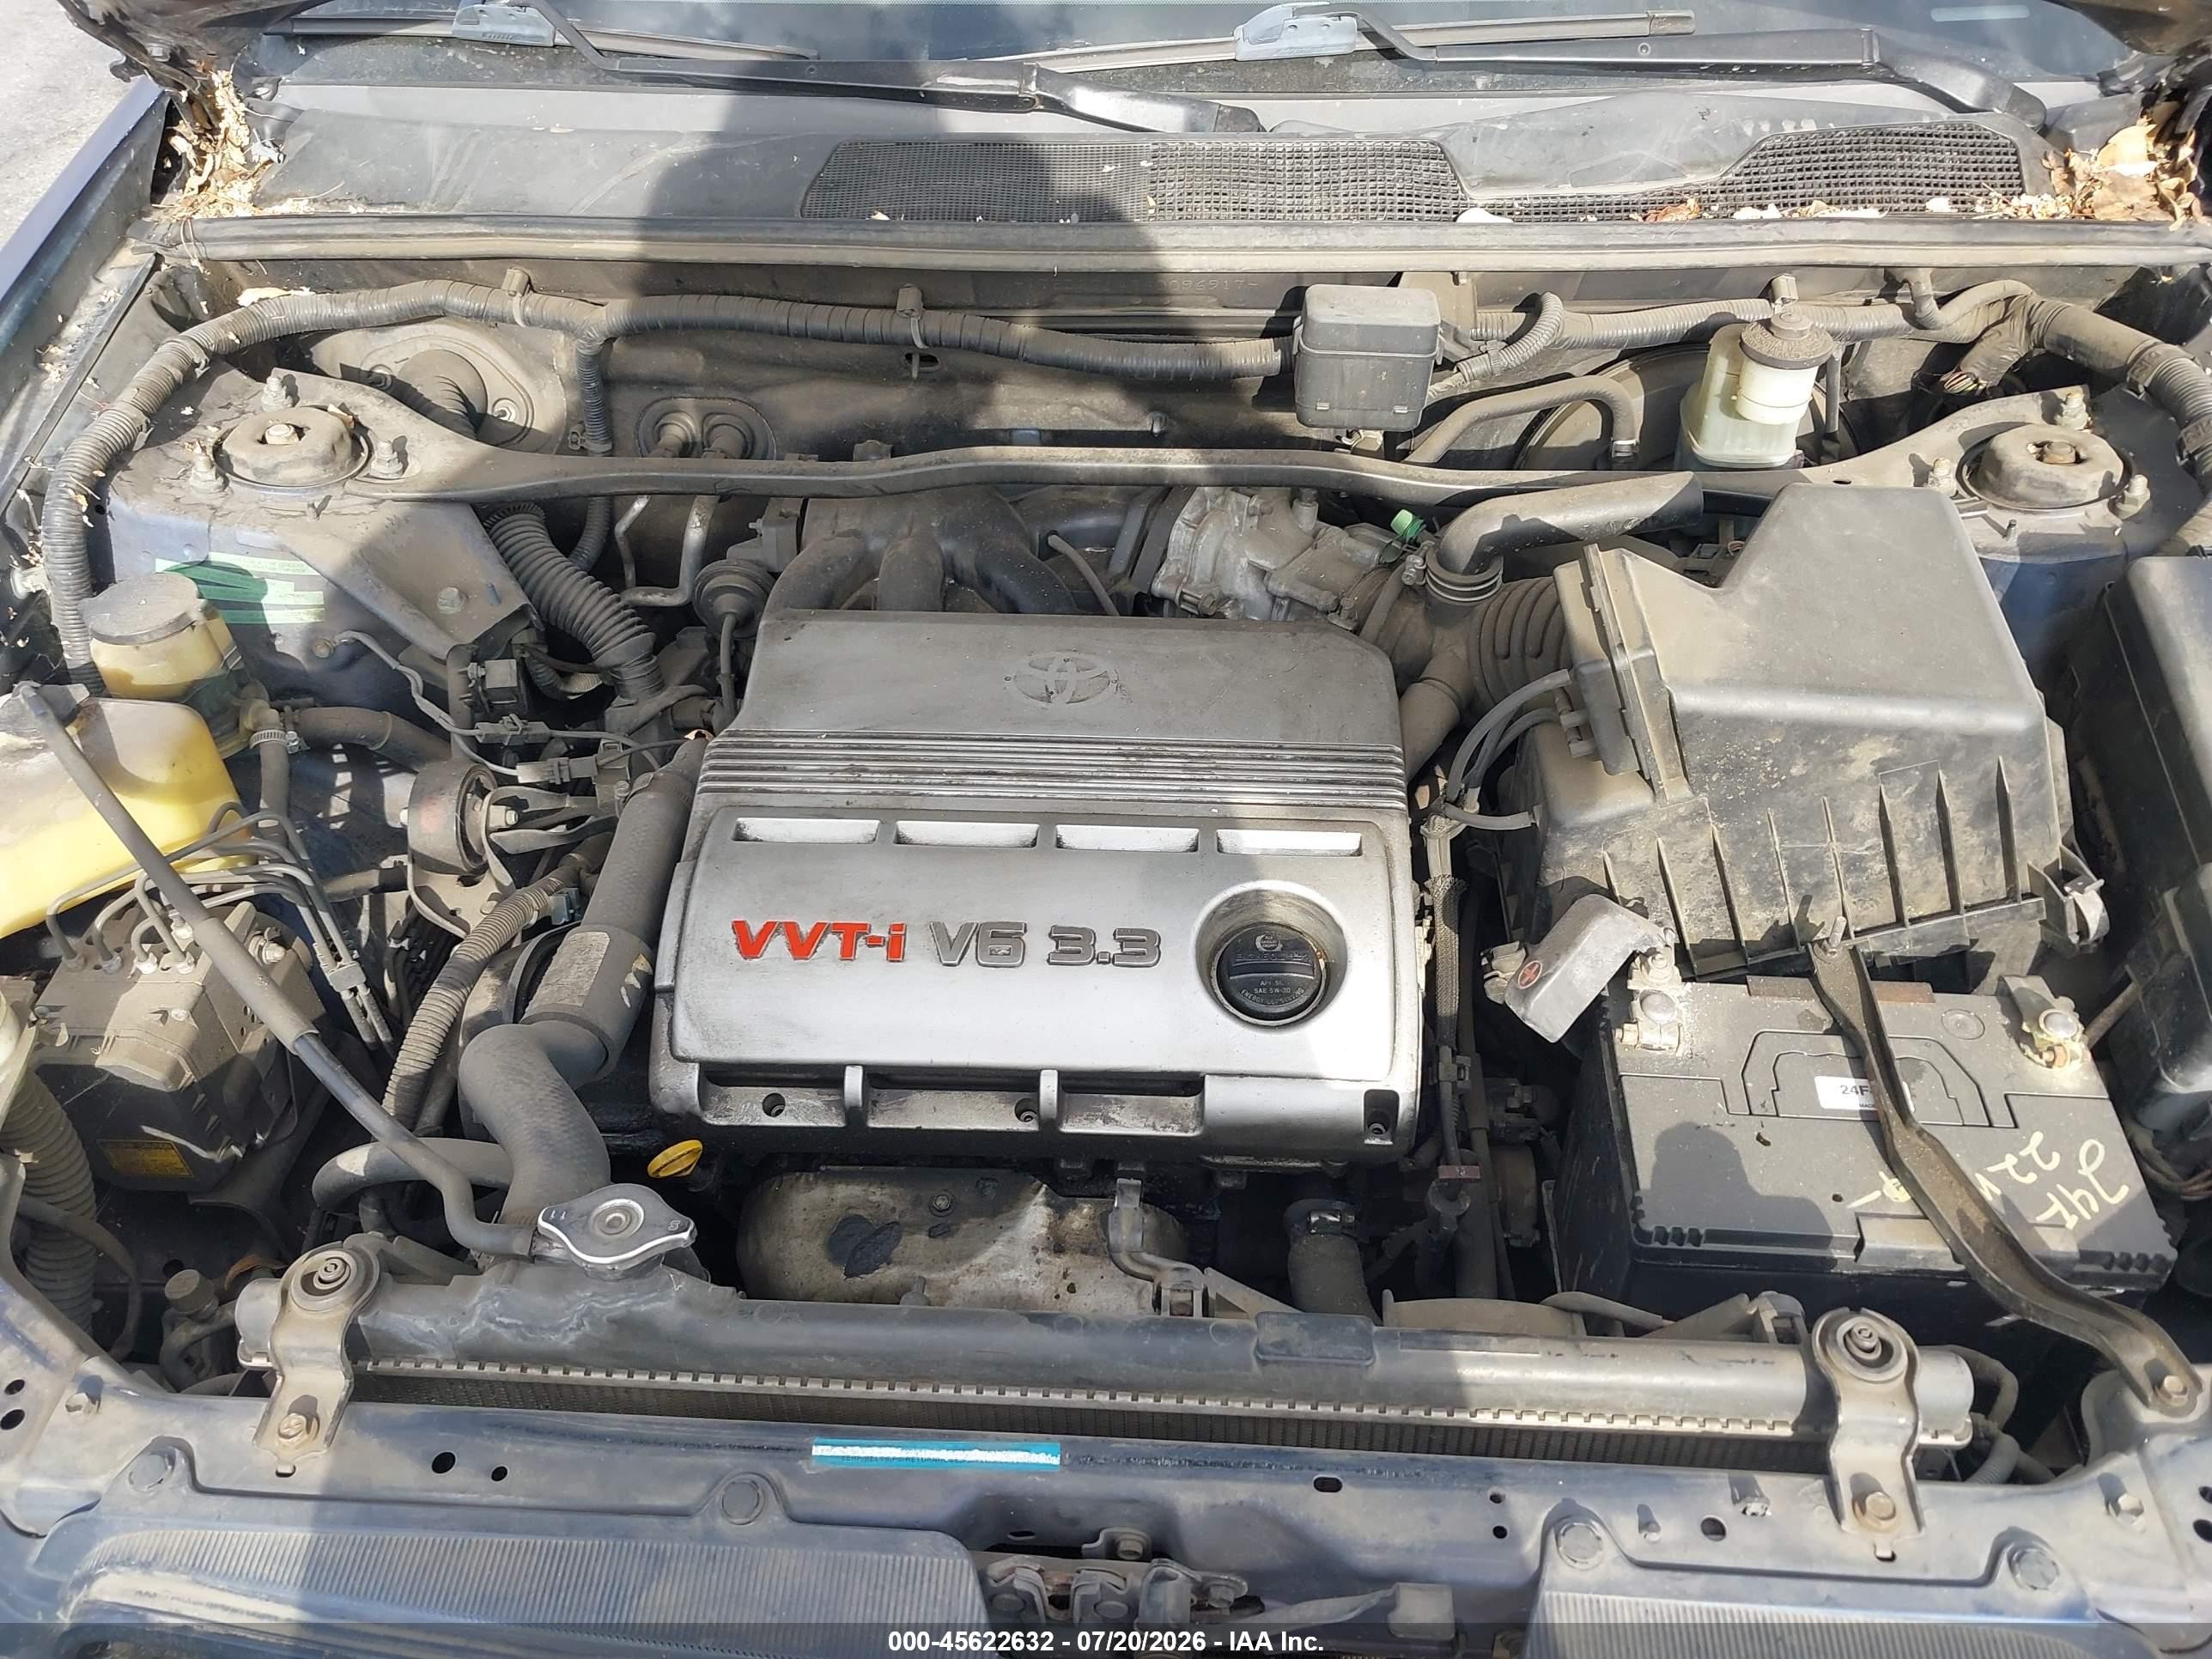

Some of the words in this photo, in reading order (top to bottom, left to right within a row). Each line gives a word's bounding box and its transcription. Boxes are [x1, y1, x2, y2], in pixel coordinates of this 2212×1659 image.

[731, 920, 908, 963] VVT-i
[928, 921, 1028, 968] V6
[1047, 925, 1162, 968] 3.3
